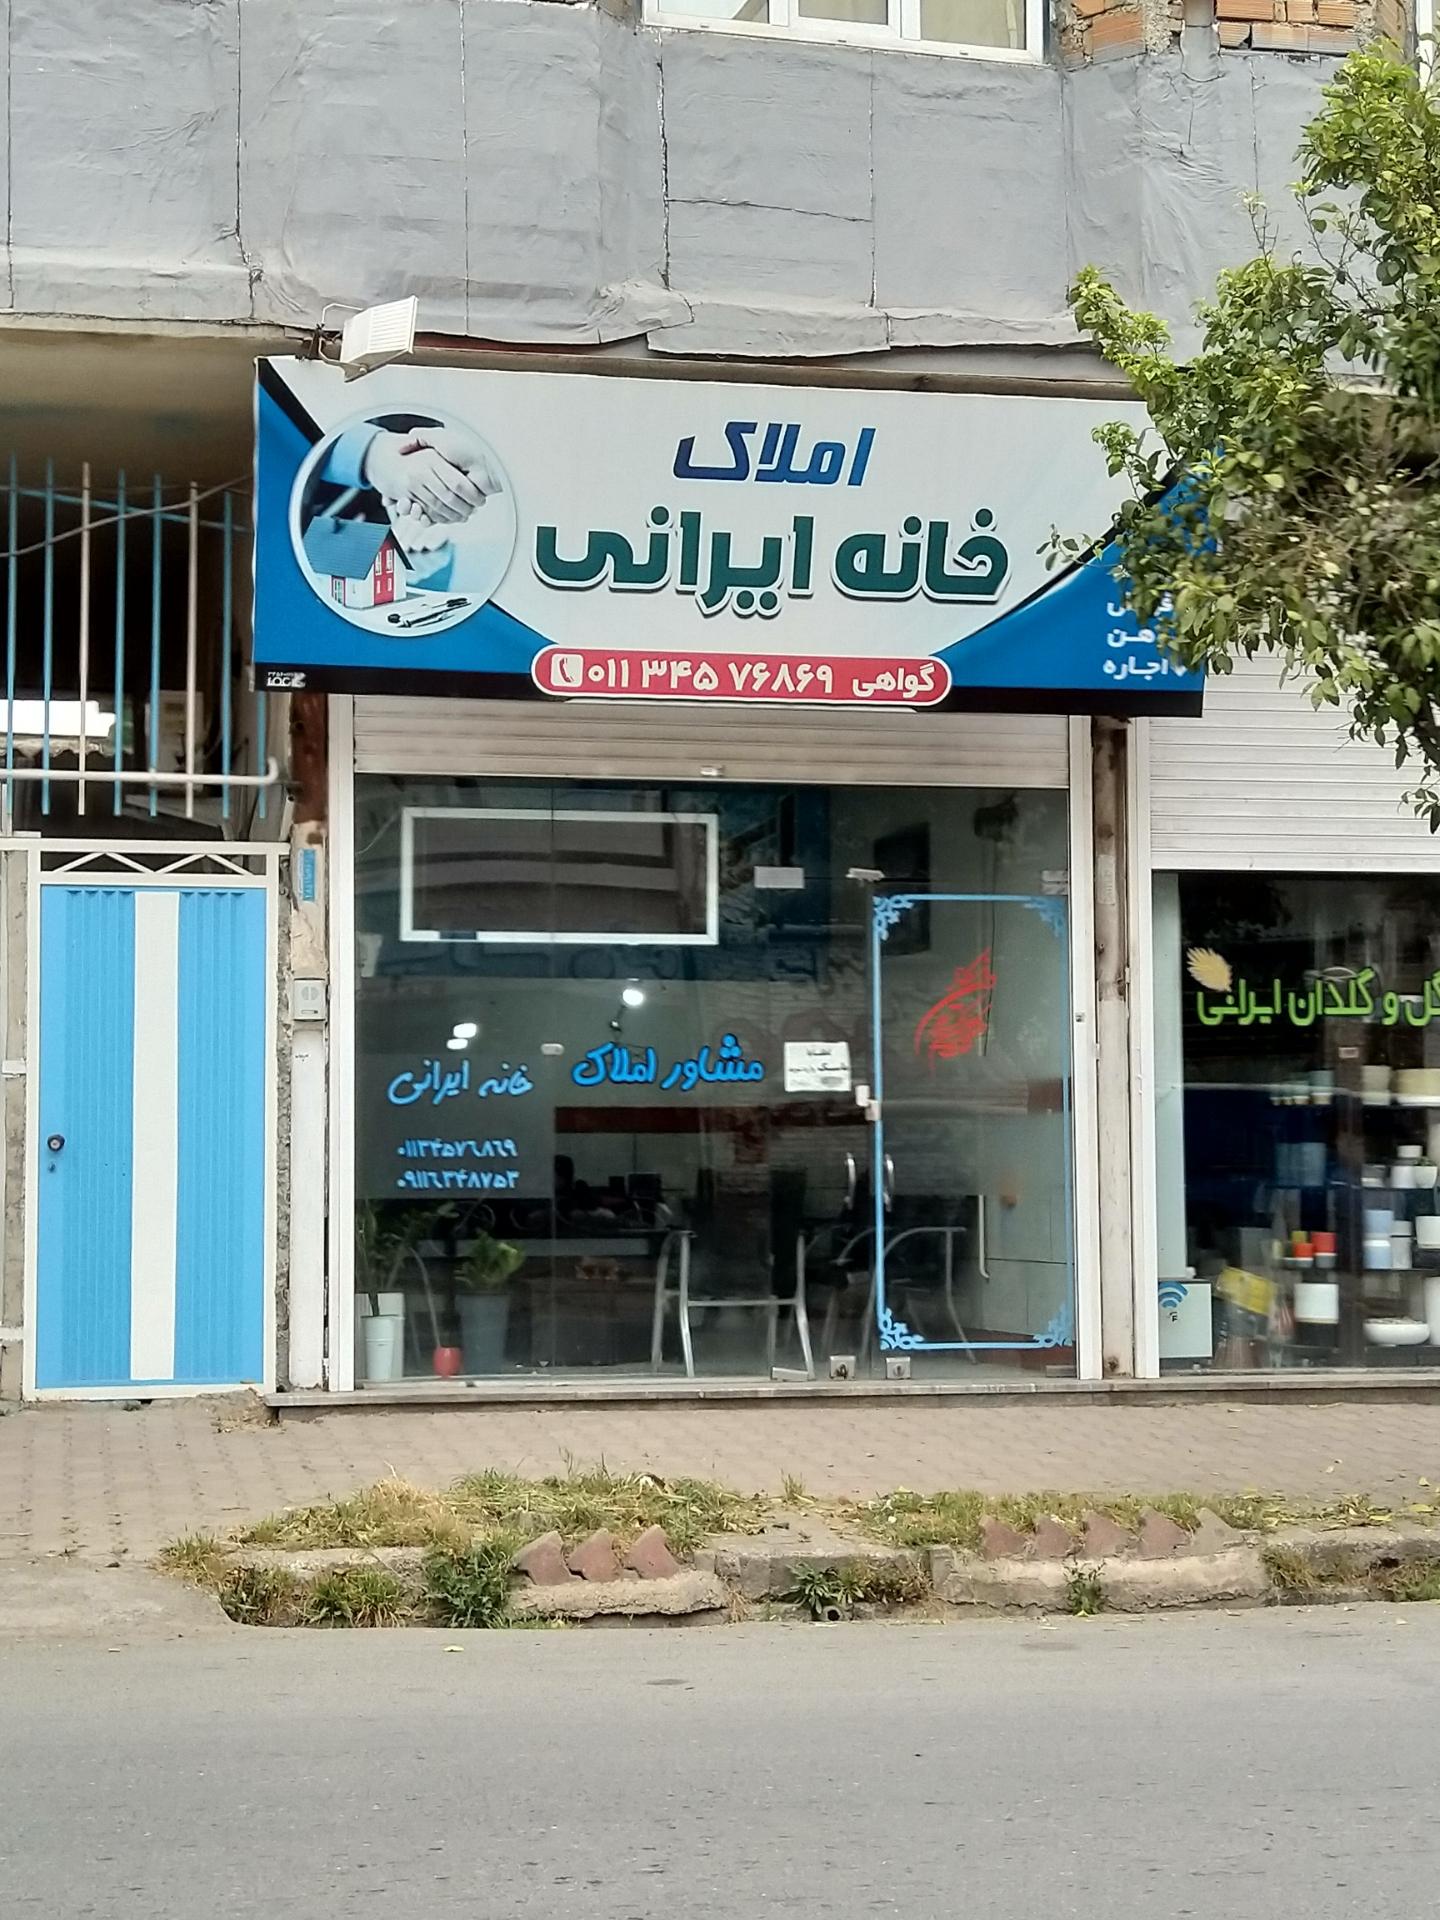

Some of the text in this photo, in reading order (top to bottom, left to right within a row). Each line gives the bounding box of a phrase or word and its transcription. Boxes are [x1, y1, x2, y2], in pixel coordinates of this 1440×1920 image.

[673, 421, 876, 487] املاک
[535, 505, 1010, 616] خانه ایرانی
[1107, 628, 1155, 648] هن
[588, 658, 935, 698] گواهی ۰۱۱ ۳۴۵ ۷۶۸۶۹
[1103, 656, 1169, 680] اجاره
[1197, 978, 1282, 1026] ایرانی
[1288, 966, 1375, 1027] گلدان
[1382, 991, 1399, 1026] و
[387, 1034, 764, 1105] مشاور املاک خانه ایرانی
